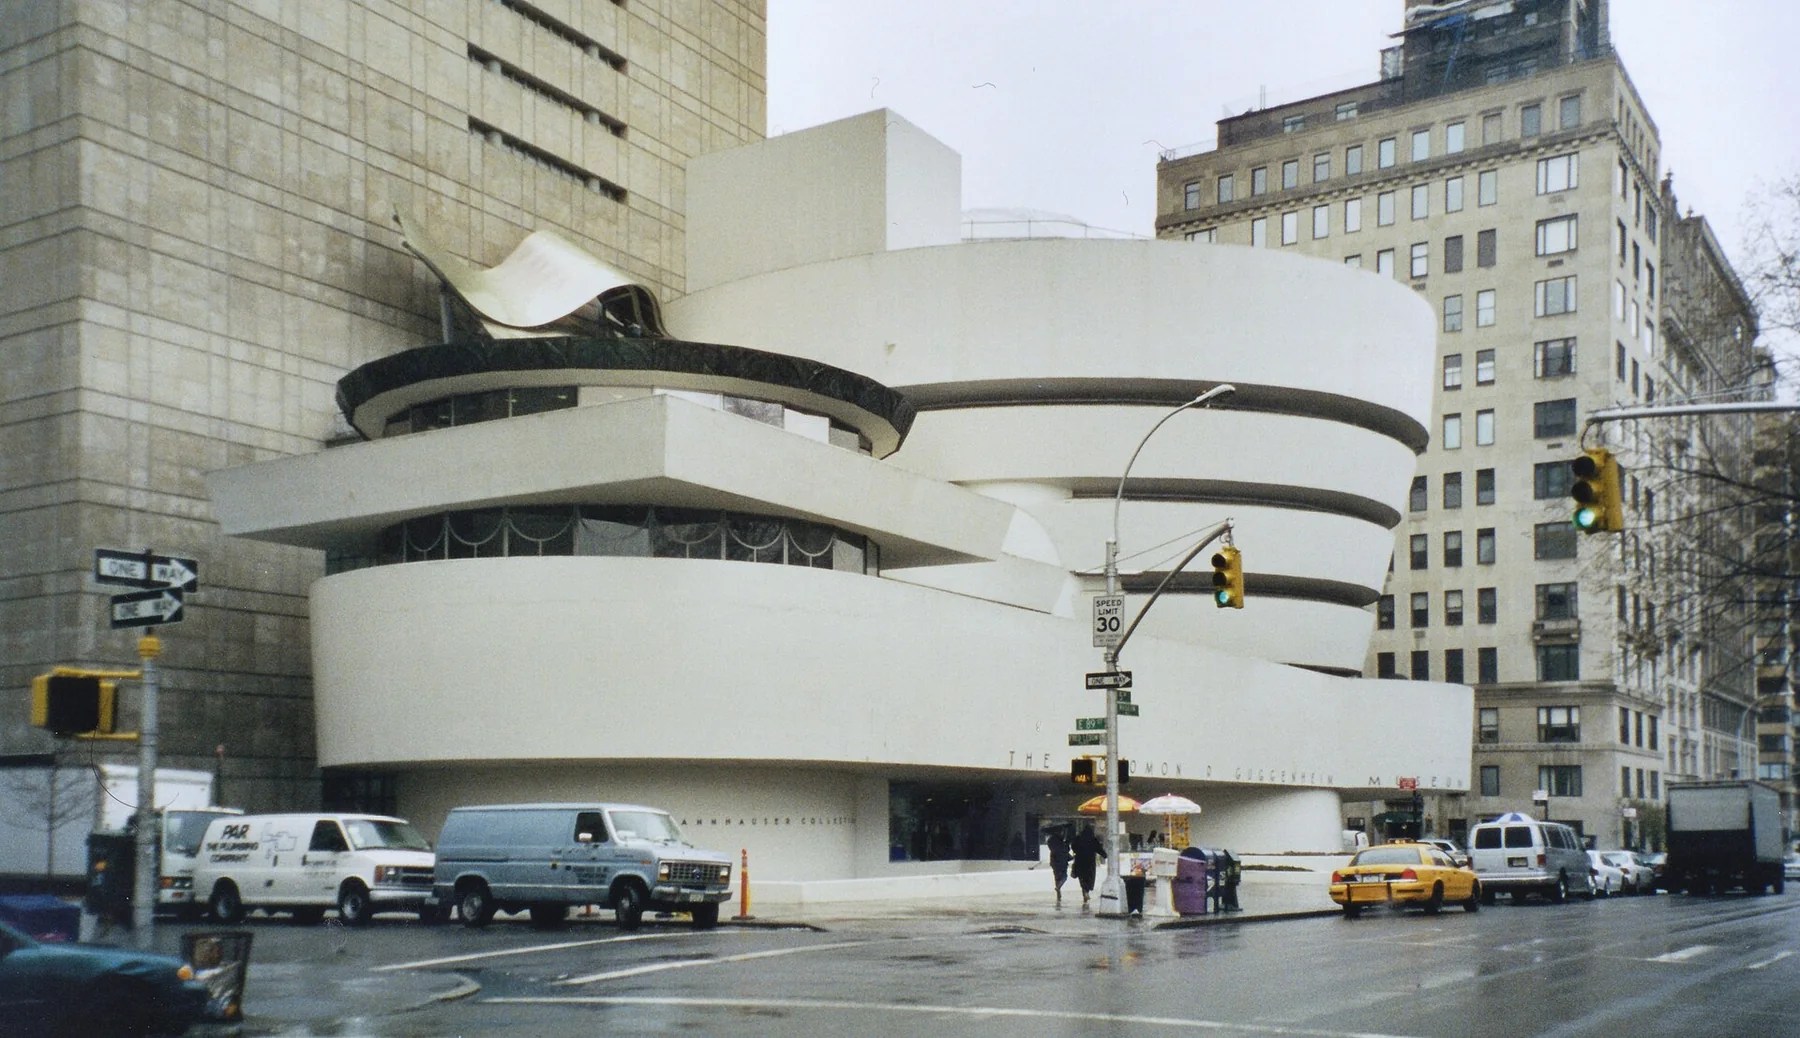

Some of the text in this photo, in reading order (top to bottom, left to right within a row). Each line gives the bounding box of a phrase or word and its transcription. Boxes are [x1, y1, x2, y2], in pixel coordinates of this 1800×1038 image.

[109, 560, 186, 580] ONE WAY
[1096, 599, 1122, 607] SPEED
[1097, 616, 1120, 632] 30
[1091, 675, 1126, 685] ONE WAY
[1078, 719, 1083, 730] E
[1086, 719, 1095, 730] 89
[1009, 750, 1050, 769] THE
[1235, 767, 1334, 784] GUGGENHEIM
[681, 817, 791, 826] ANNHAUSER
[221, 824, 250, 840] PAR
